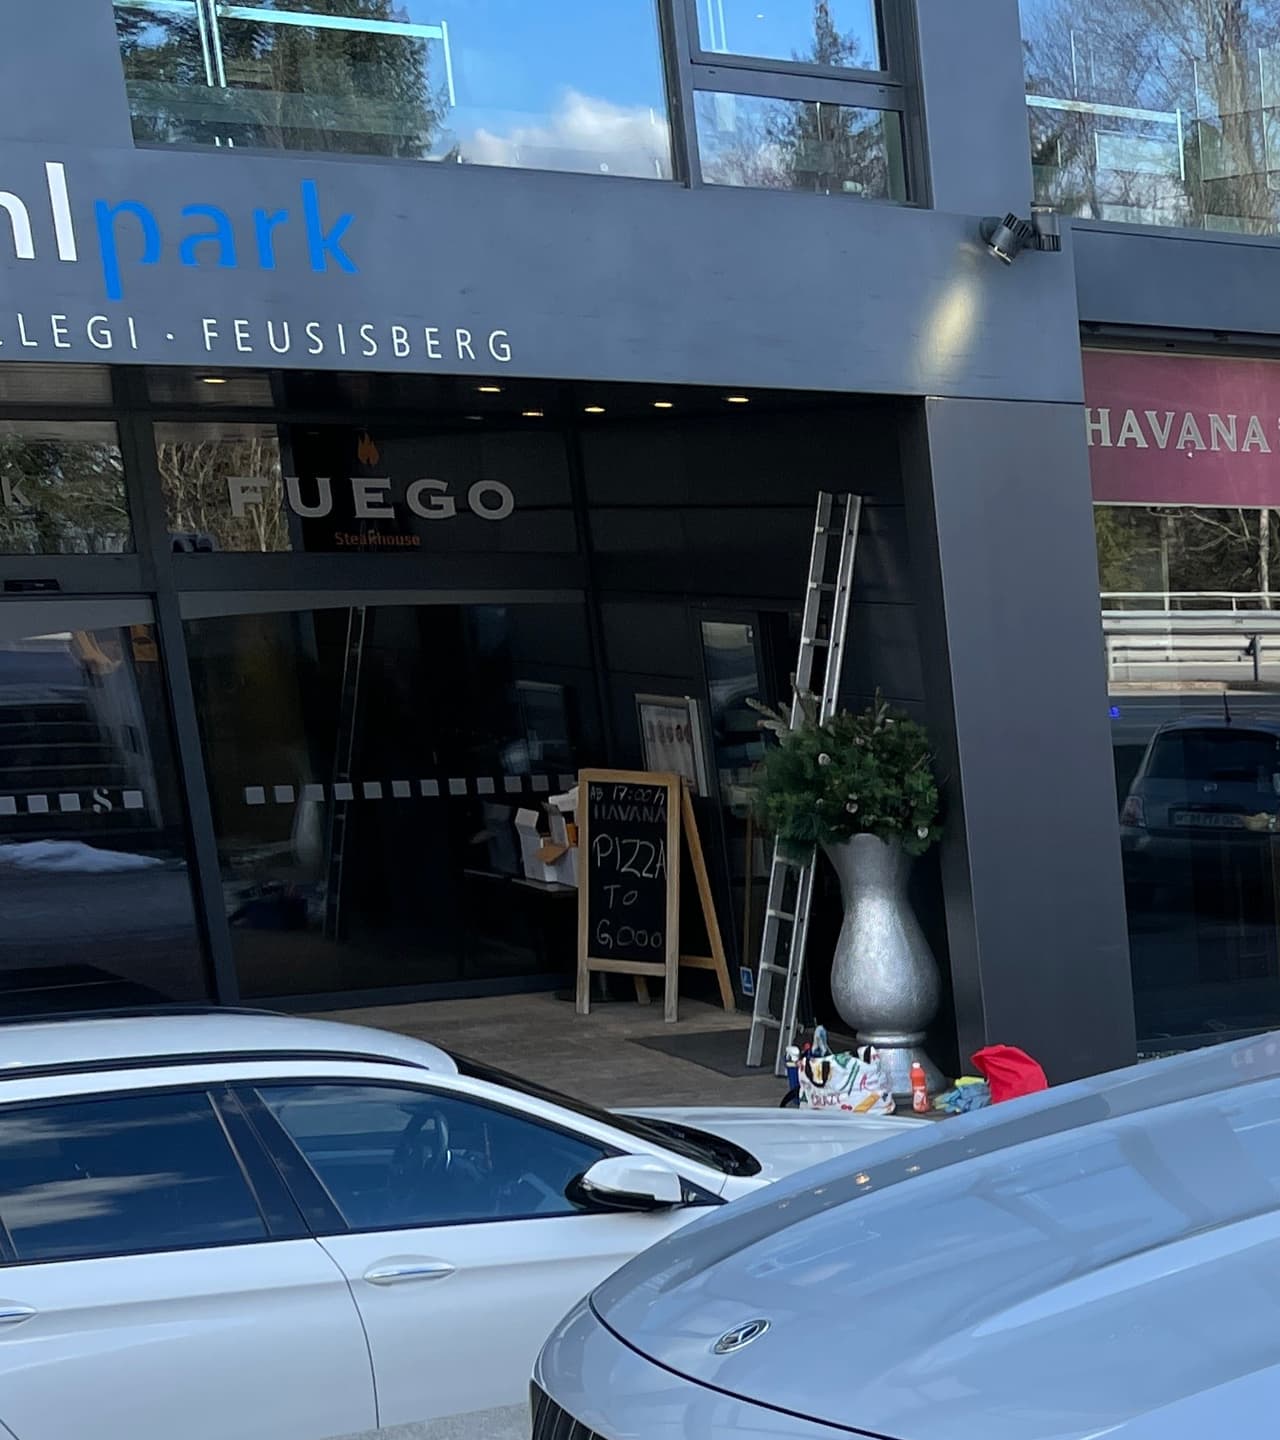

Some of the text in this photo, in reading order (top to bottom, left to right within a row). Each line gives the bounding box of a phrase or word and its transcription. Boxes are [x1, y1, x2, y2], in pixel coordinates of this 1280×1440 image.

[0, 313, 513, 362] LEGI FEUSISBERG
[1084, 407, 1271, 453] HAVANA
[227, 476, 515, 521] FUEGO
[335, 530, 421, 547] Steakhouse
[594, 804, 667, 825] HAVANA
[593, 833, 668, 881] PIZZA
